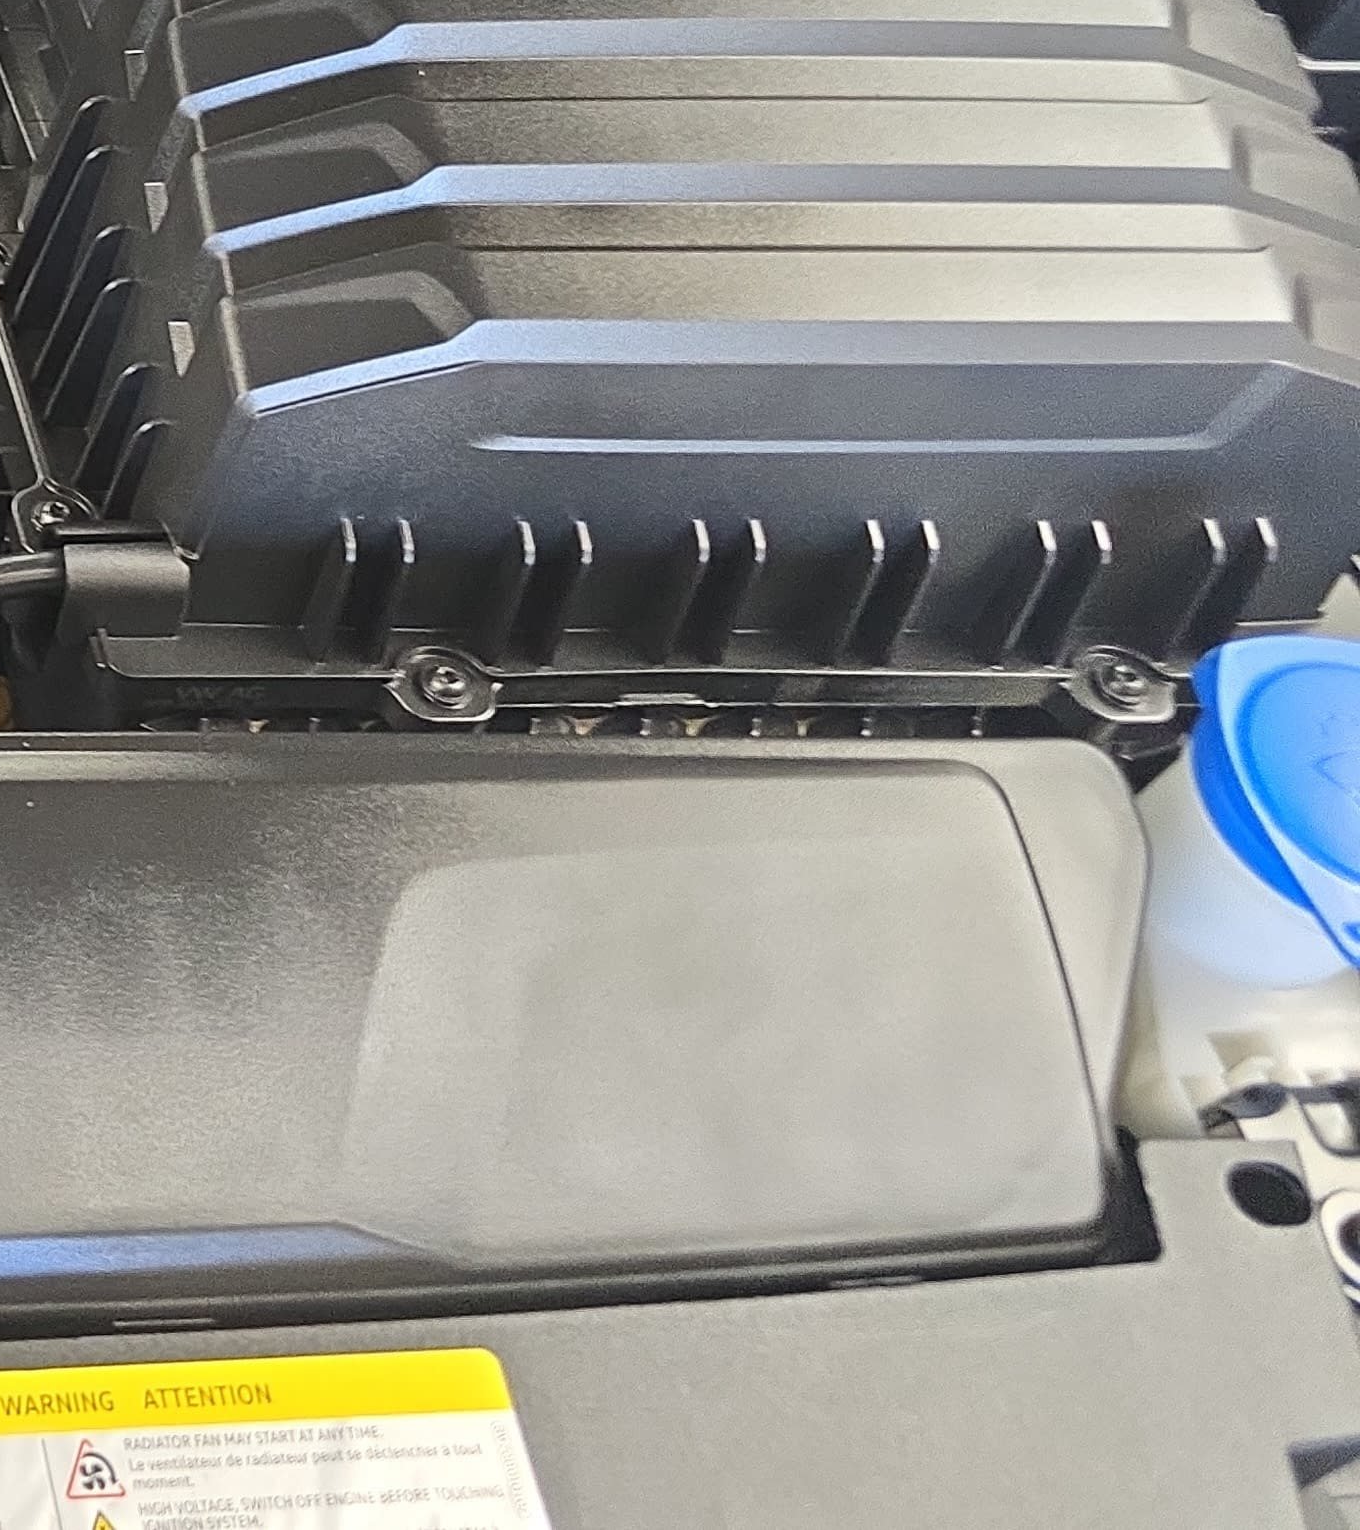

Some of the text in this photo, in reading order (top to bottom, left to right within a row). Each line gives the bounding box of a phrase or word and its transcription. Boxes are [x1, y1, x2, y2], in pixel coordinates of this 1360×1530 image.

[0, 1383, 273, 1416] WARNING ATTENTION
[123, 1432, 192, 1451] RADIATOR
[194, 1432, 221, 1448] FAN
[224, 1431, 252, 1446] MAY
[256, 1429, 295, 1445] START
[299, 1428, 314, 1442] AT
[129, 1458, 145, 1472] Le
[148, 1454, 222, 1471] ventilateur
[225, 1453, 243, 1468] de
[245, 1451, 309, 1467] radiateur
[312, 1449, 344, 1465] peut
[346, 1449, 363, 1461] se
[452, 1442, 483, 1457] tout
[132, 1474, 196, 1490] moment.
[137, 1500, 173, 1516] HIGH
[176, 1497, 240, 1516] VOLTAGE,
[241, 1494, 294, 1511] SWITCH
[295, 1492, 321, 1508] OFF
[325, 1490, 377, 1506] ENGINE
[380, 1487, 431, 1504] BEFORE
